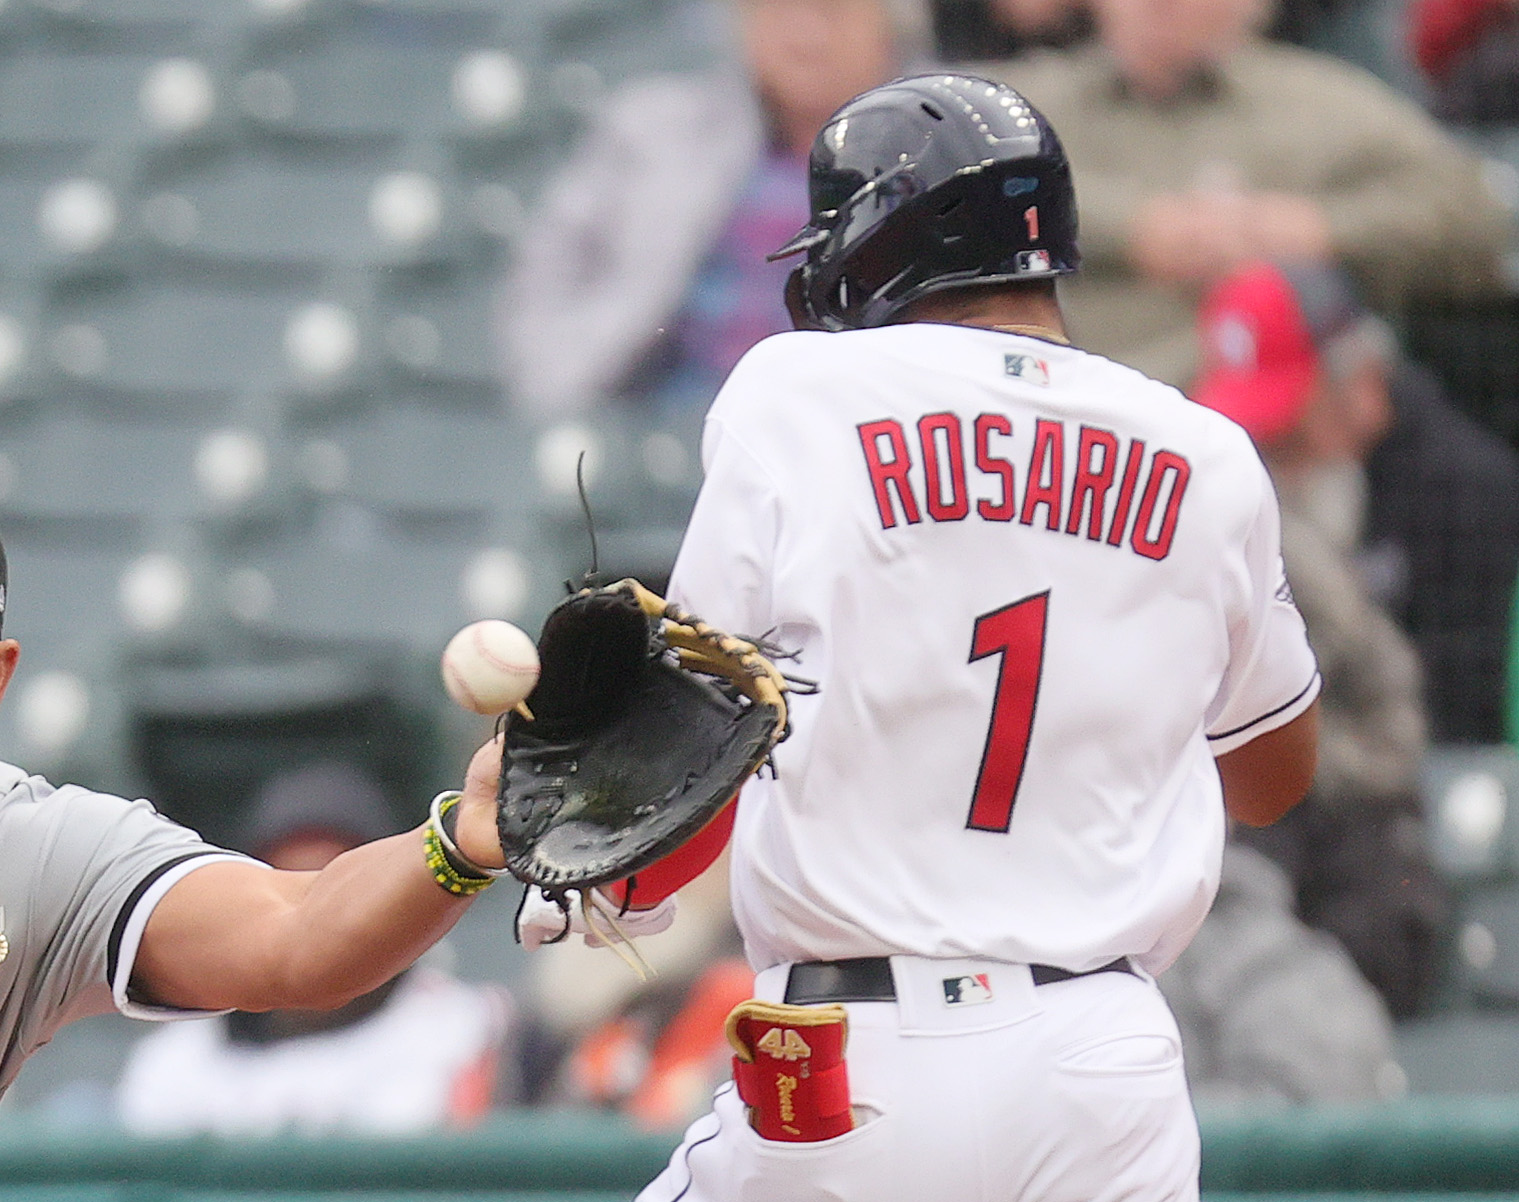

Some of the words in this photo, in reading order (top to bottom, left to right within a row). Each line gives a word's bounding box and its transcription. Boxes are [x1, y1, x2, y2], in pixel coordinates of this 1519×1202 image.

[1024, 205, 1039, 240] 1
[856, 411, 1192, 562] ROSARIO
[965, 587, 1052, 834] 1
